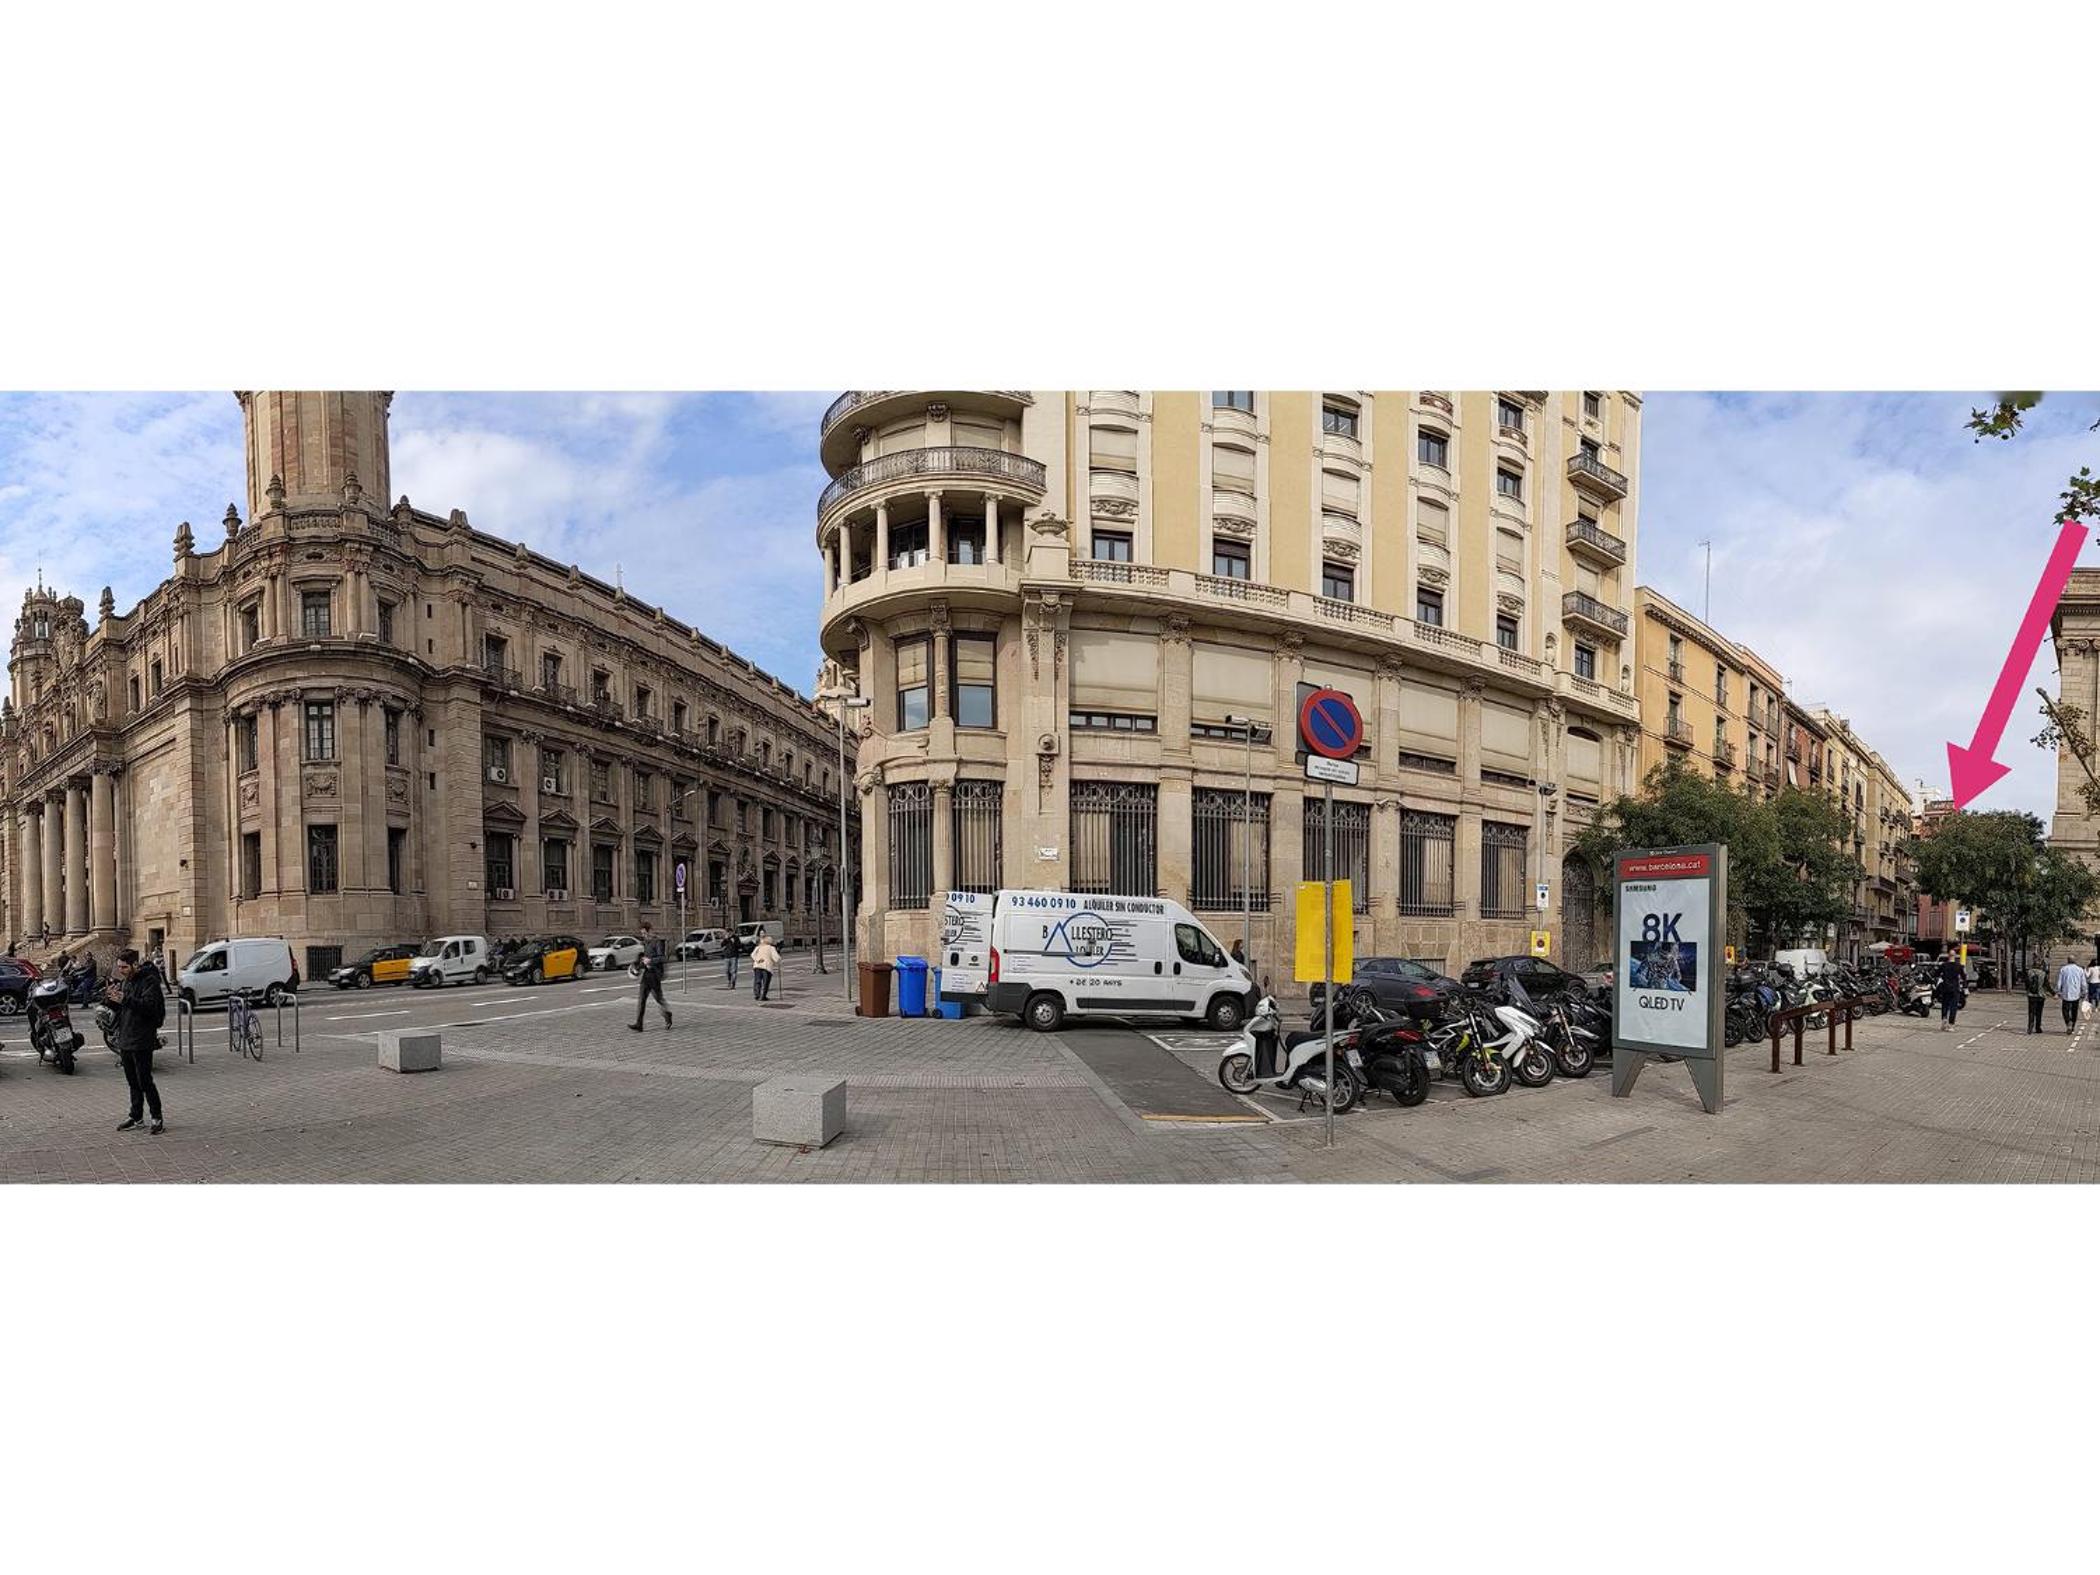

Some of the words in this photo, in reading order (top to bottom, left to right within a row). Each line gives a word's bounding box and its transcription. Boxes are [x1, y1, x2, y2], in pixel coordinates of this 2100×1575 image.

[1629, 860, 1701, 872] www.barcelona.cat
[1625, 884, 1657, 892] SAMSUNG
[951, 892, 963, 902] 09
[965, 894, 976, 903] 10
[1011, 896, 1025, 907] 93
[1027, 897, 1048, 908] 460
[1050, 898, 1063, 909] 09
[1066, 898, 1076, 909] 10
[1083, 899, 1114, 911] ALQUILER
[1115, 901, 1127, 912] SIN
[1127, 902, 1165, 915] CONDUCTOR
[1642, 912, 1683, 943] 8K
[1089, 978, 1101, 986] 20
[1638, 995, 1668, 1011] QLED
[1669, 998, 1685, 1011] TV
